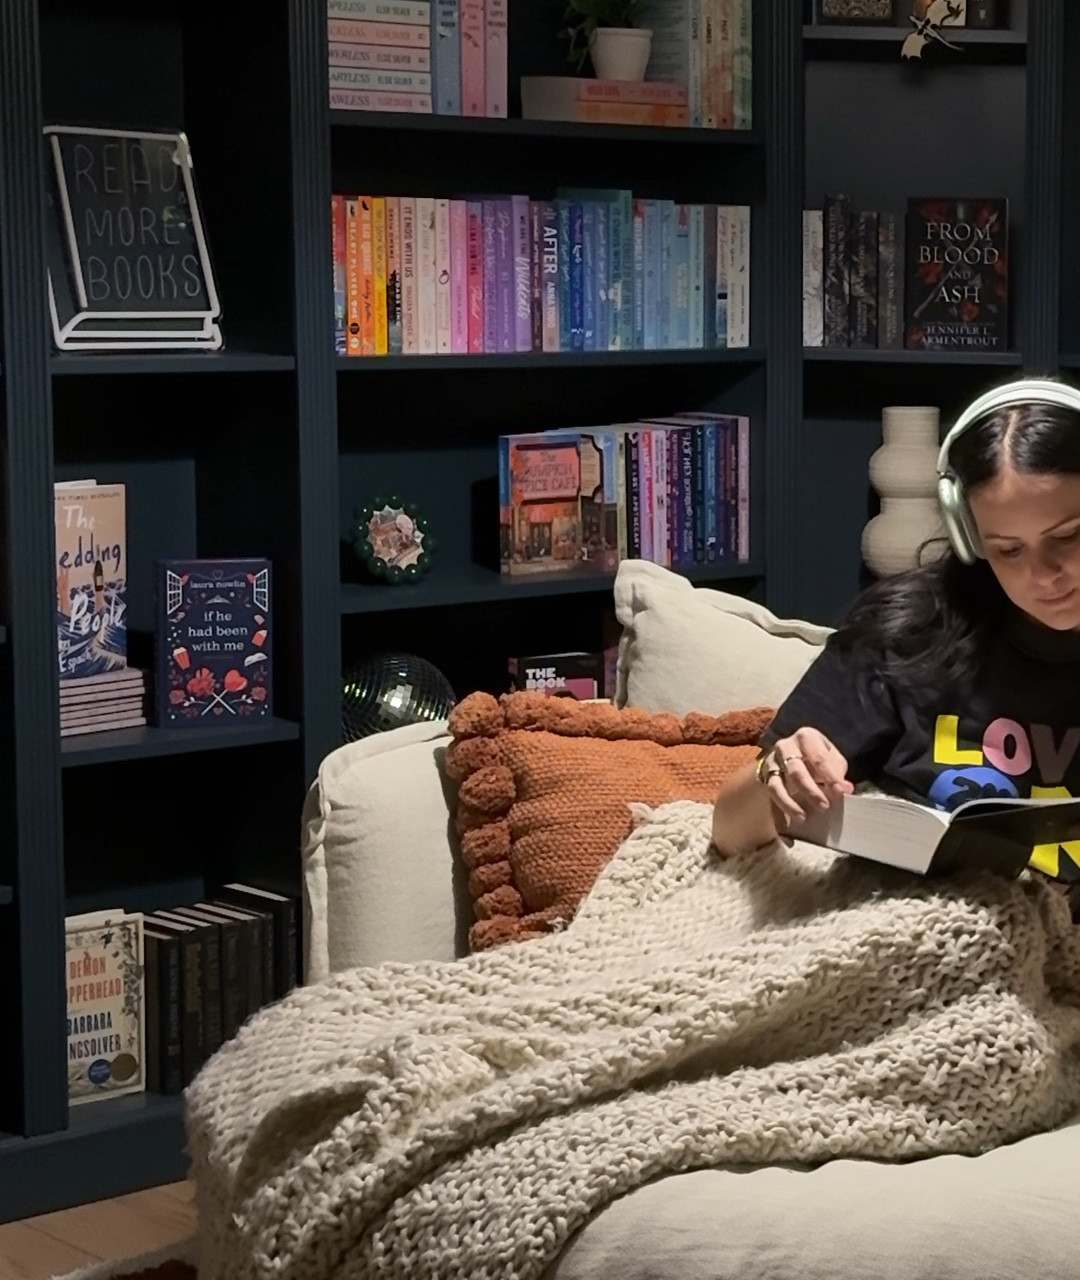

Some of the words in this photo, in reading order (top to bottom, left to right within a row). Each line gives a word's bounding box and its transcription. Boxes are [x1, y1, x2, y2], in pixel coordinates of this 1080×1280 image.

[74, 144, 178, 194] READ
[404, 206, 412, 216] IT
[85, 206, 180, 246] MORE
[350, 222, 359, 254] READY
[404, 217, 413, 240] ENDS
[925, 221, 994, 241] FROM
[404, 241, 413, 265] WITH
[542, 226, 558, 274] AFTER
[918, 245, 1000, 266] BLOOD
[88, 254, 201, 301] BOOKS
[350, 258, 359, 296] PLAYER
[404, 266, 413, 278] US
[947, 271, 972, 280] AND
[514, 255, 531, 321] Wildcats
[546, 280, 556, 305] ANNA
[935, 285, 982, 304] ASH
[546, 305, 556, 329] TODD
[920, 336, 1000, 347] ARMENTROUT
[927, 325, 982, 336] JENNIFER
[523, 463, 573, 479] PUMPKIN
[63, 505, 97, 531] The
[59, 532, 122, 574] edding
[190, 581, 215, 589] laura
[215, 581, 247, 590] nowlin
[69, 592, 125, 636] People
[203, 611, 215, 622] if
[216, 611, 233, 622] he
[188, 626, 213, 637] had
[216, 626, 249, 637] been
[192, 641, 221, 652] with
[223, 642, 245, 652] me
[525, 667, 557, 679] THE
[69, 956, 107, 980] DEMON
[69, 978, 122, 1004] PPERHEAD
[66, 1011, 112, 1036] BARBARA
[69, 1033, 122, 1060] NGSOLVER
